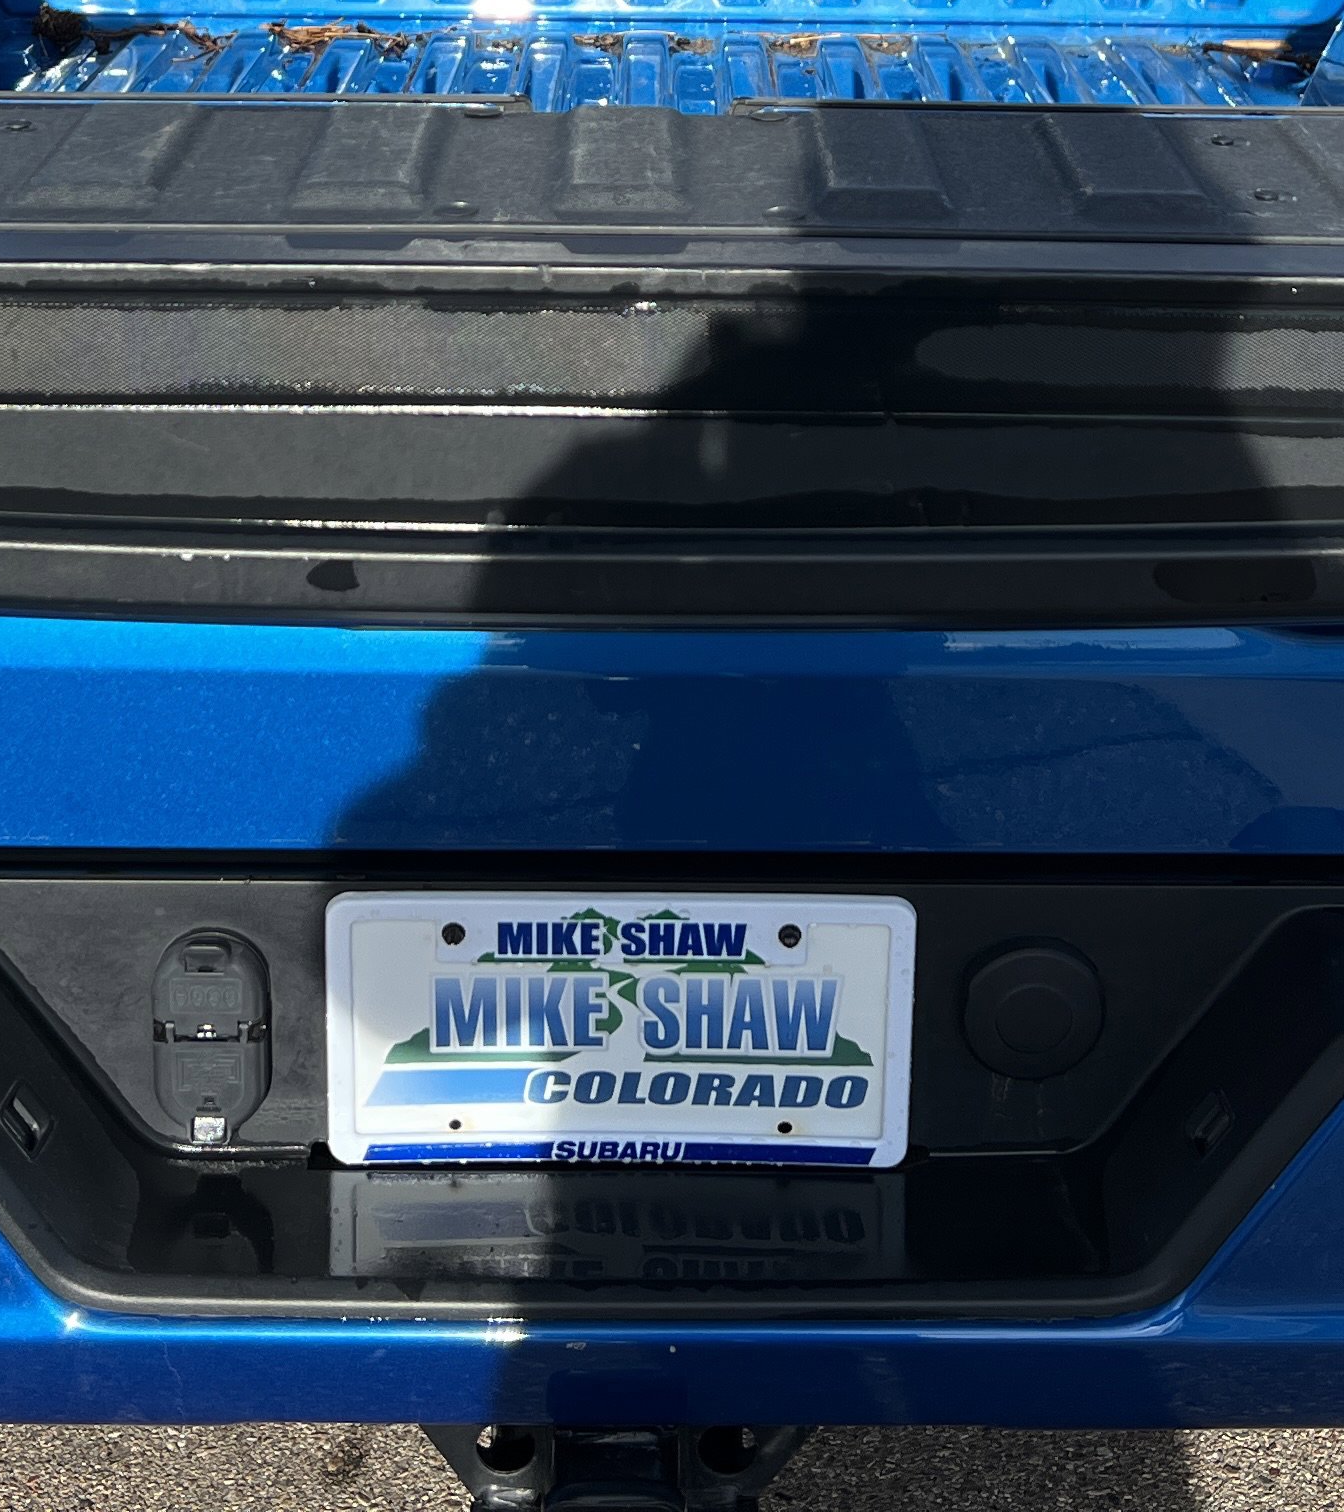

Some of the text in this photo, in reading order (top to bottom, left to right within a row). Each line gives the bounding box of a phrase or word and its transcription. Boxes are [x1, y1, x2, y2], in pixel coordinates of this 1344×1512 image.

[497, 922, 747, 958] MIKE SHAW
[434, 976, 838, 1051] MIKE SHAW
[528, 1071, 870, 1109] COLORADO
[554, 1140, 684, 1162] SUBARU
